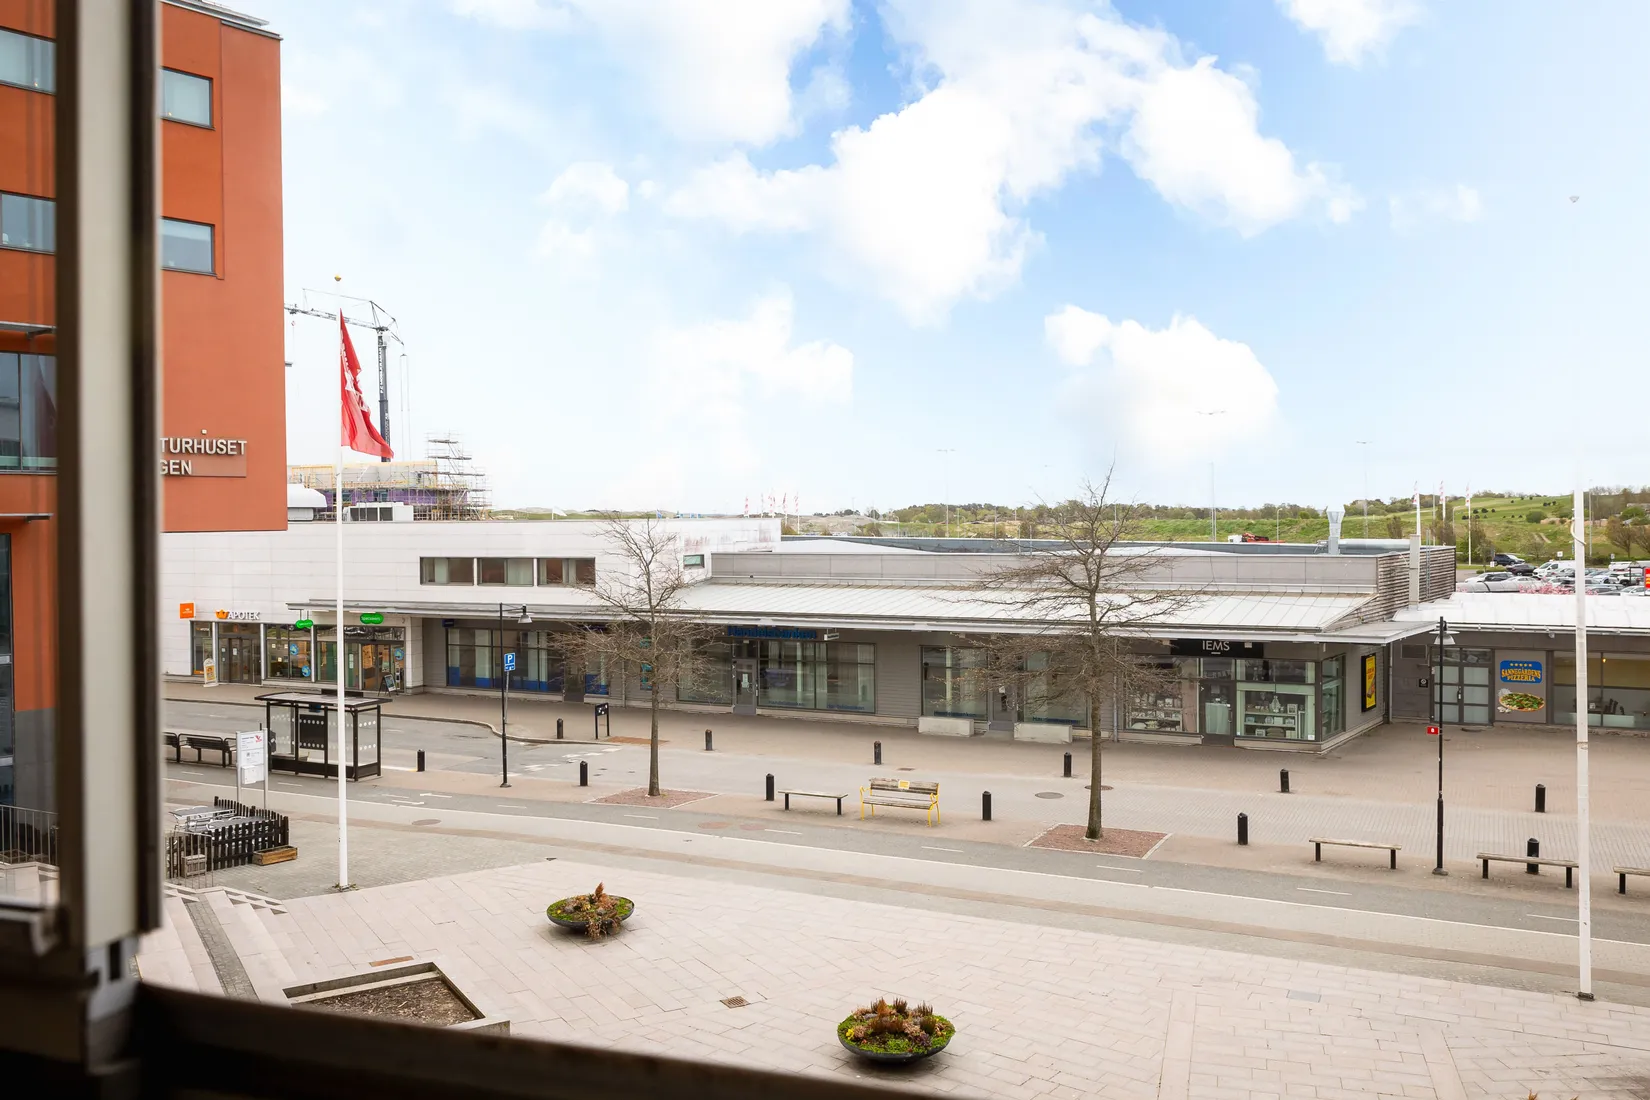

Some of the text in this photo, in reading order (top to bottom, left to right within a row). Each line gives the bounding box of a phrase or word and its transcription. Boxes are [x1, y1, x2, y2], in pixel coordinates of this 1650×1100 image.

[228, 611, 260, 620] APOTEK
[1202, 640, 1230, 651] IEMS
[507, 654, 513, 664] P
